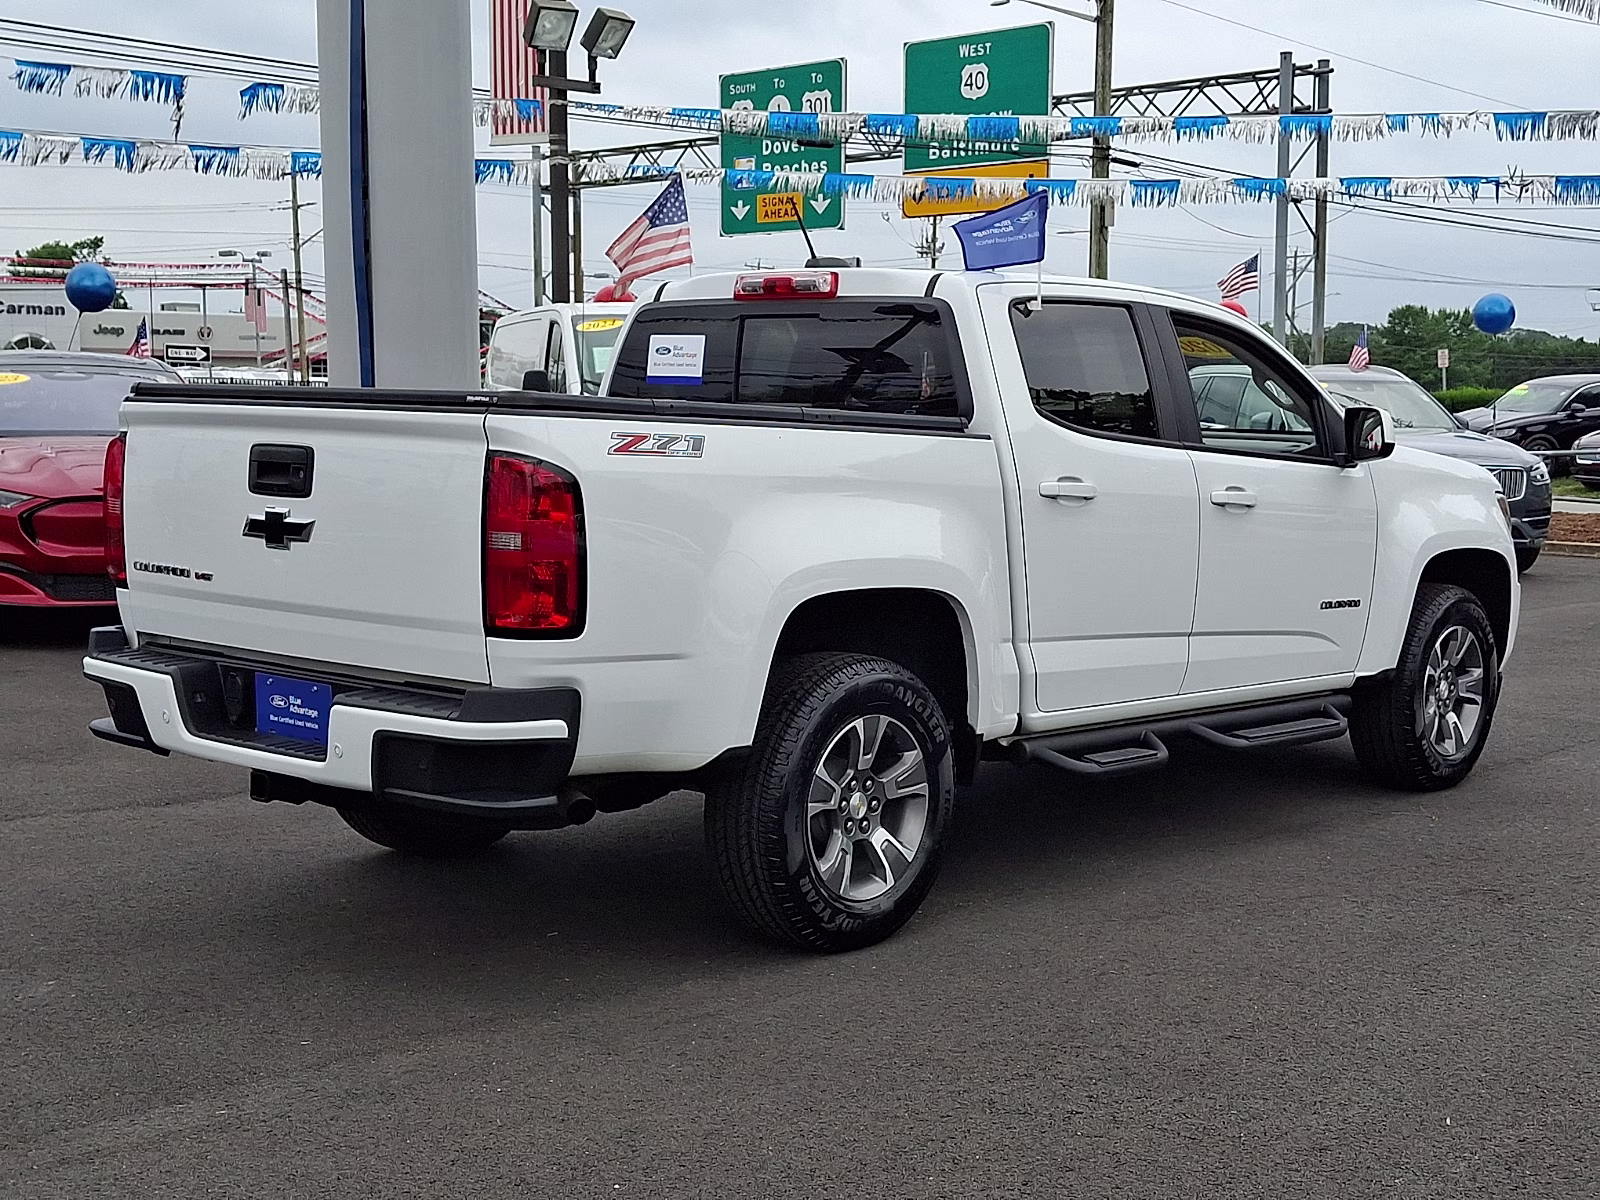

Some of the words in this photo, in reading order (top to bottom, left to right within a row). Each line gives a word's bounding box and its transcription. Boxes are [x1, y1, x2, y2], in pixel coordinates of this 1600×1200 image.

[959, 43, 992, 58] WEST
[963, 71, 985, 91] 40
[729, 83, 756, 95] SOUTH
[805, 97, 828, 113] 301
[93, 323, 125, 337] Jeep
[608, 432, 706, 458] Z71
[289, 695, 302, 705] Blue
[289, 705, 319, 718] Advantage
